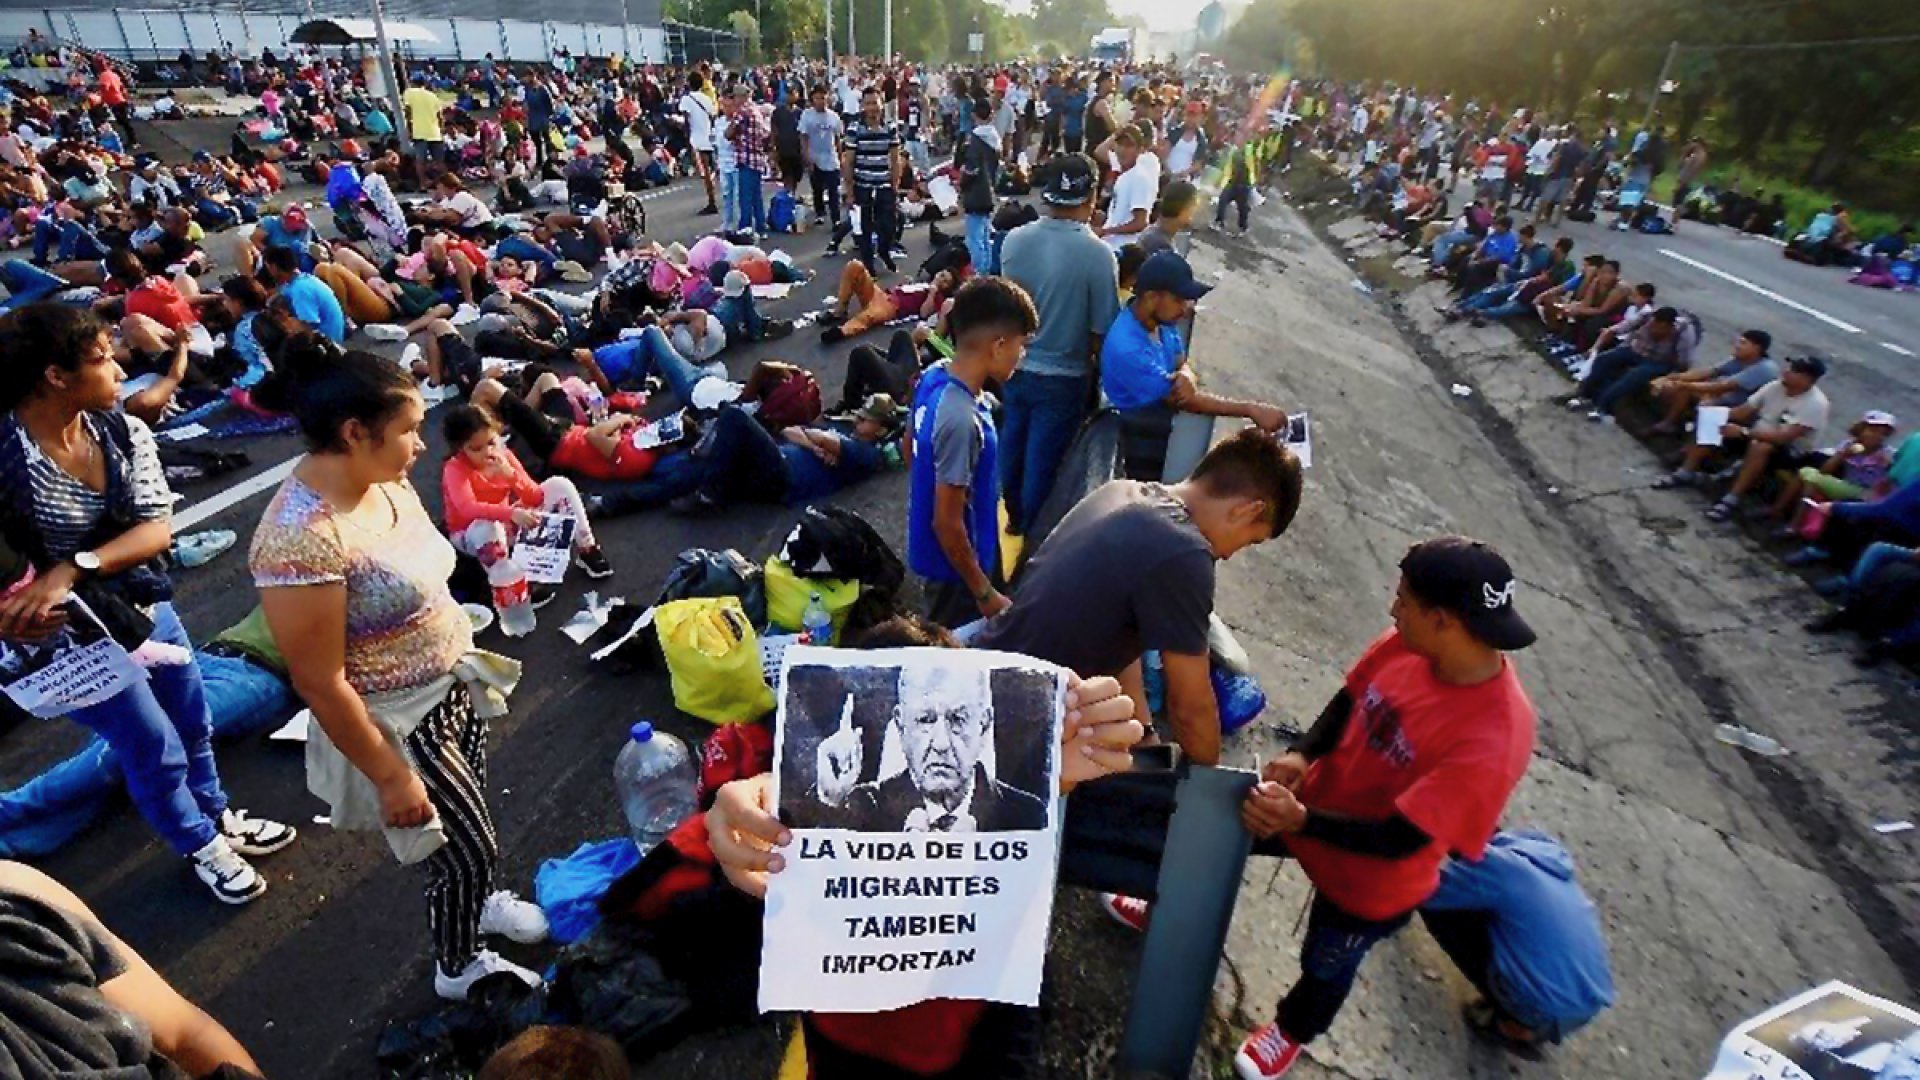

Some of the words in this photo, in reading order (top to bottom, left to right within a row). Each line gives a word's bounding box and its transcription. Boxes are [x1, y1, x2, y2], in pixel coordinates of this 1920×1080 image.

[800, 837, 836, 860] LA
[845, 841, 915, 861] VIDA
[926, 841, 964, 859] DE
[974, 841, 1029, 861] LOS
[824, 876, 1000, 898] MIGRANTES
[845, 913, 976, 938] TAMBIEN
[822, 948, 976, 974] IMPORTAN
